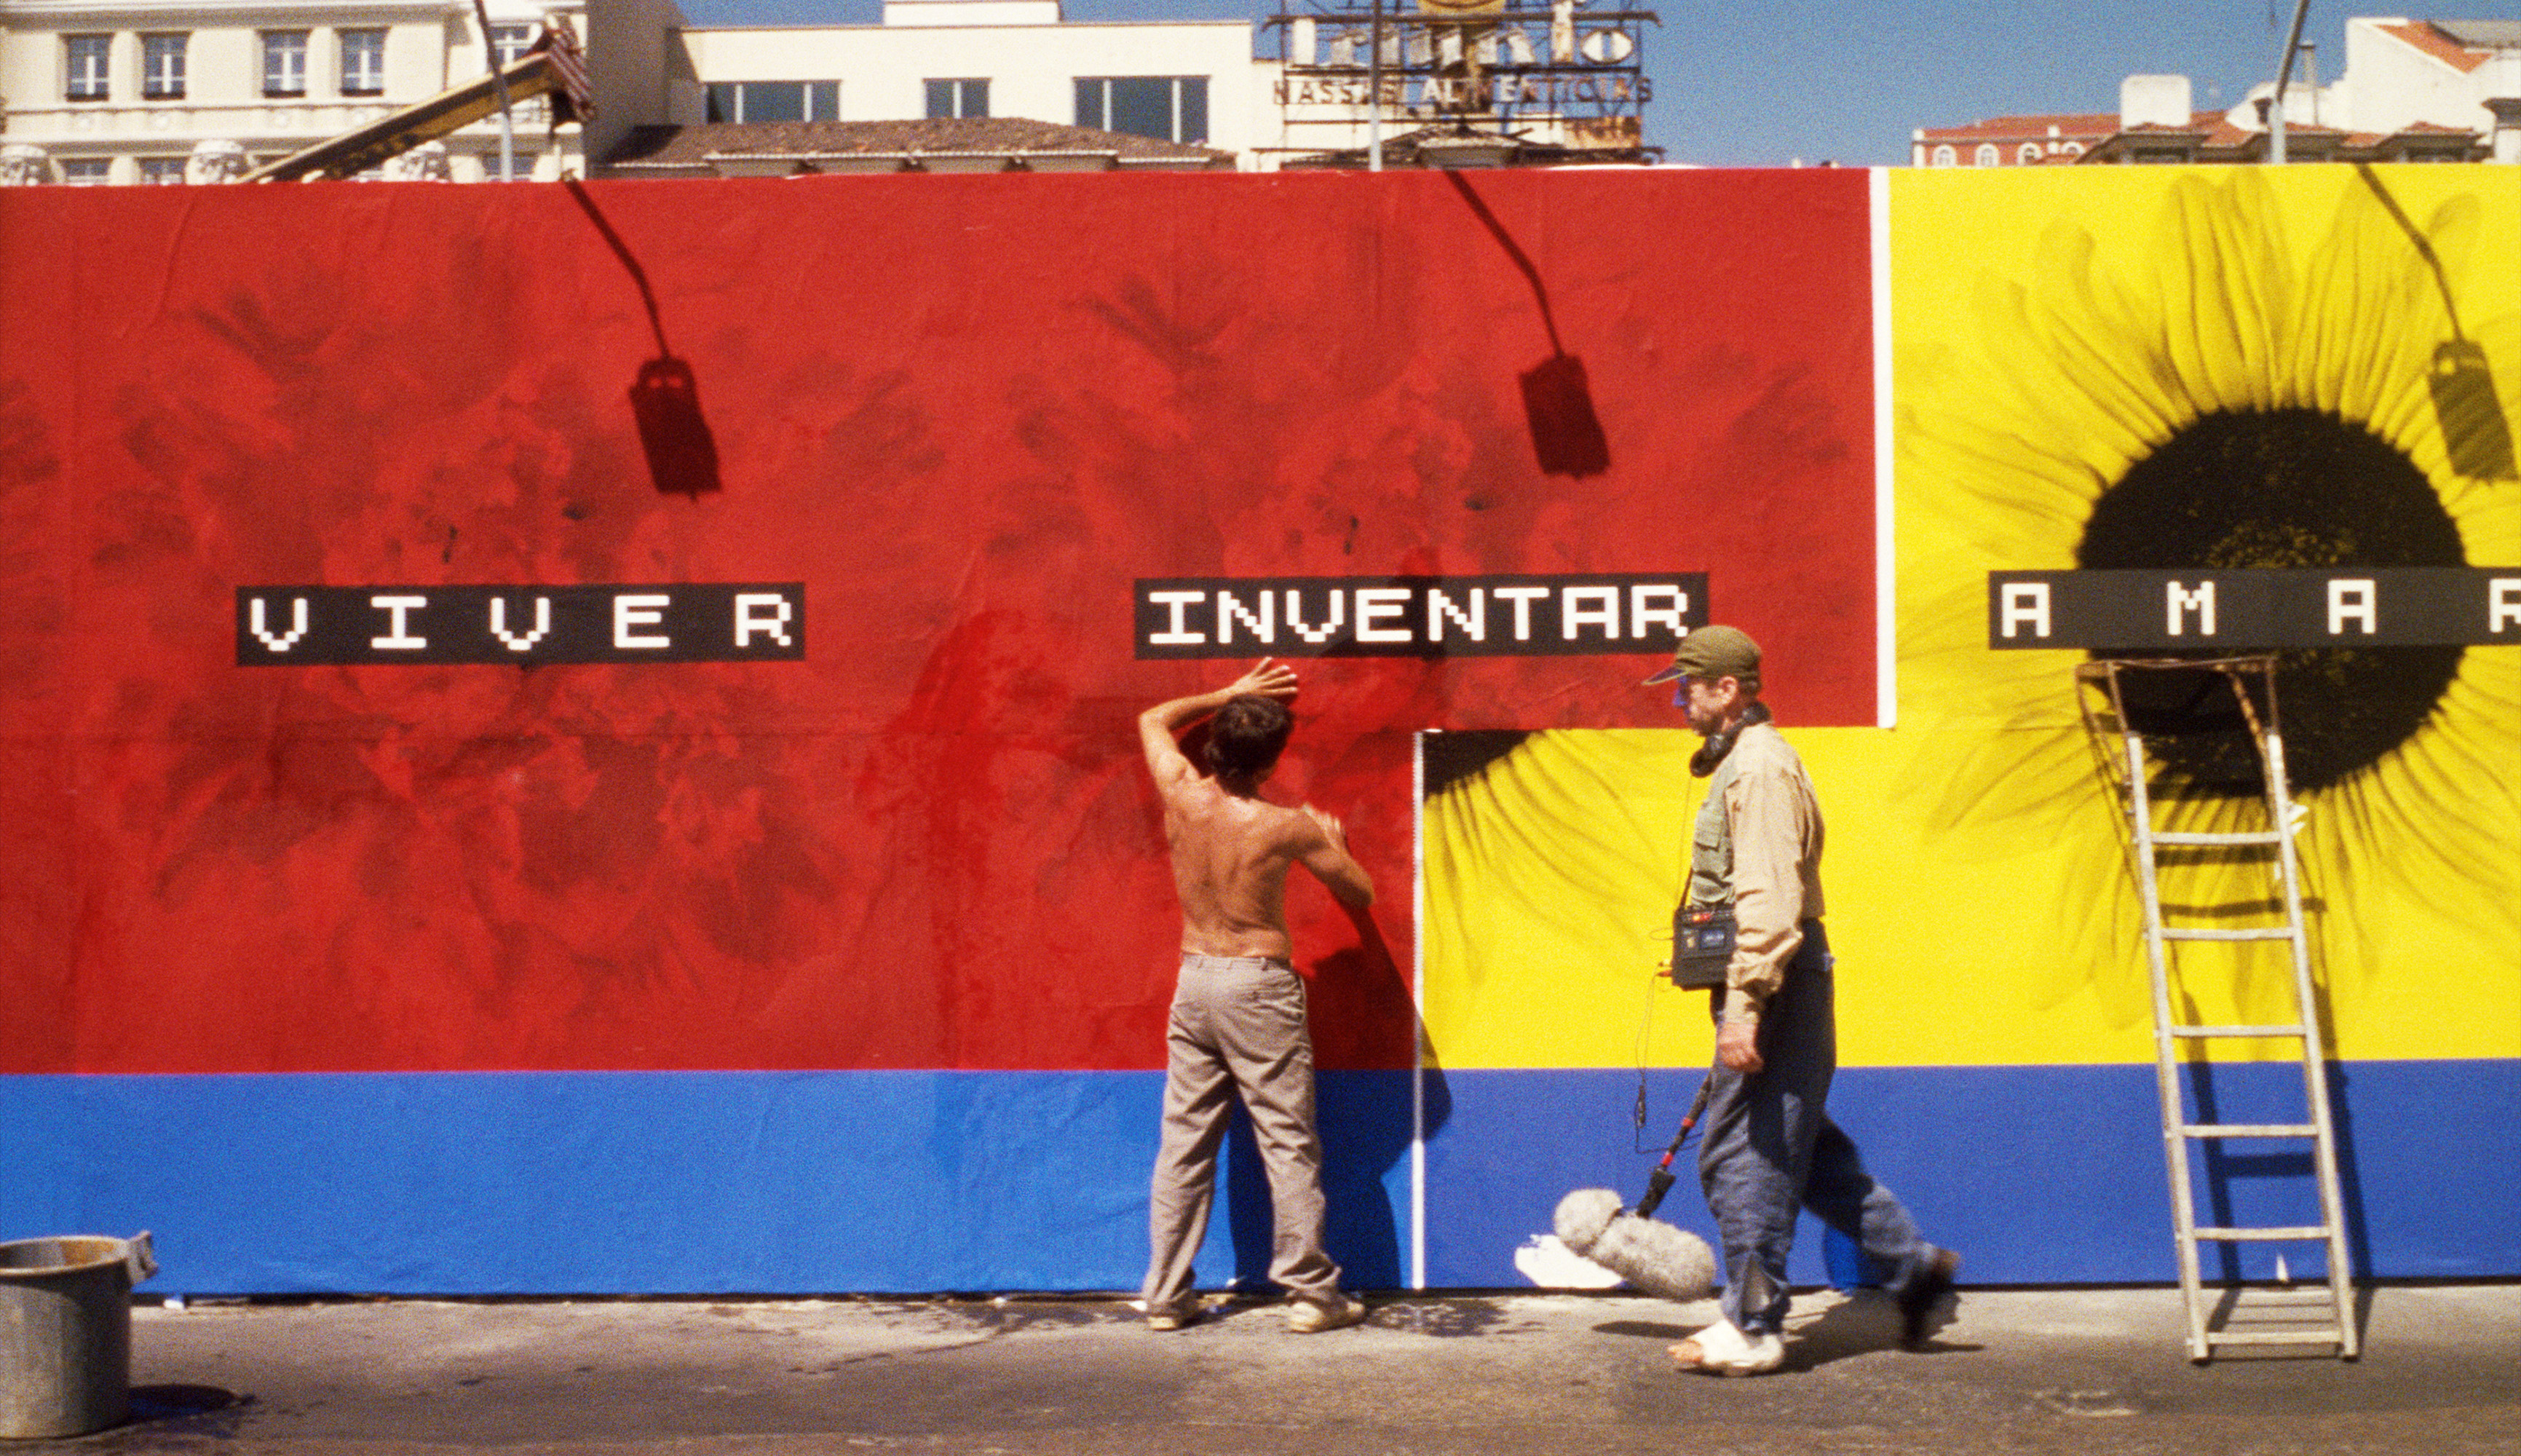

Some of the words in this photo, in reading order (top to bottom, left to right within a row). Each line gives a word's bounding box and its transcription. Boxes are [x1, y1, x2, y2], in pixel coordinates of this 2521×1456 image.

[250, 593, 793, 652] VIVER
[1148, 585, 1689, 644] INVENTAR
[2000, 578, 2521, 638] AMAR
